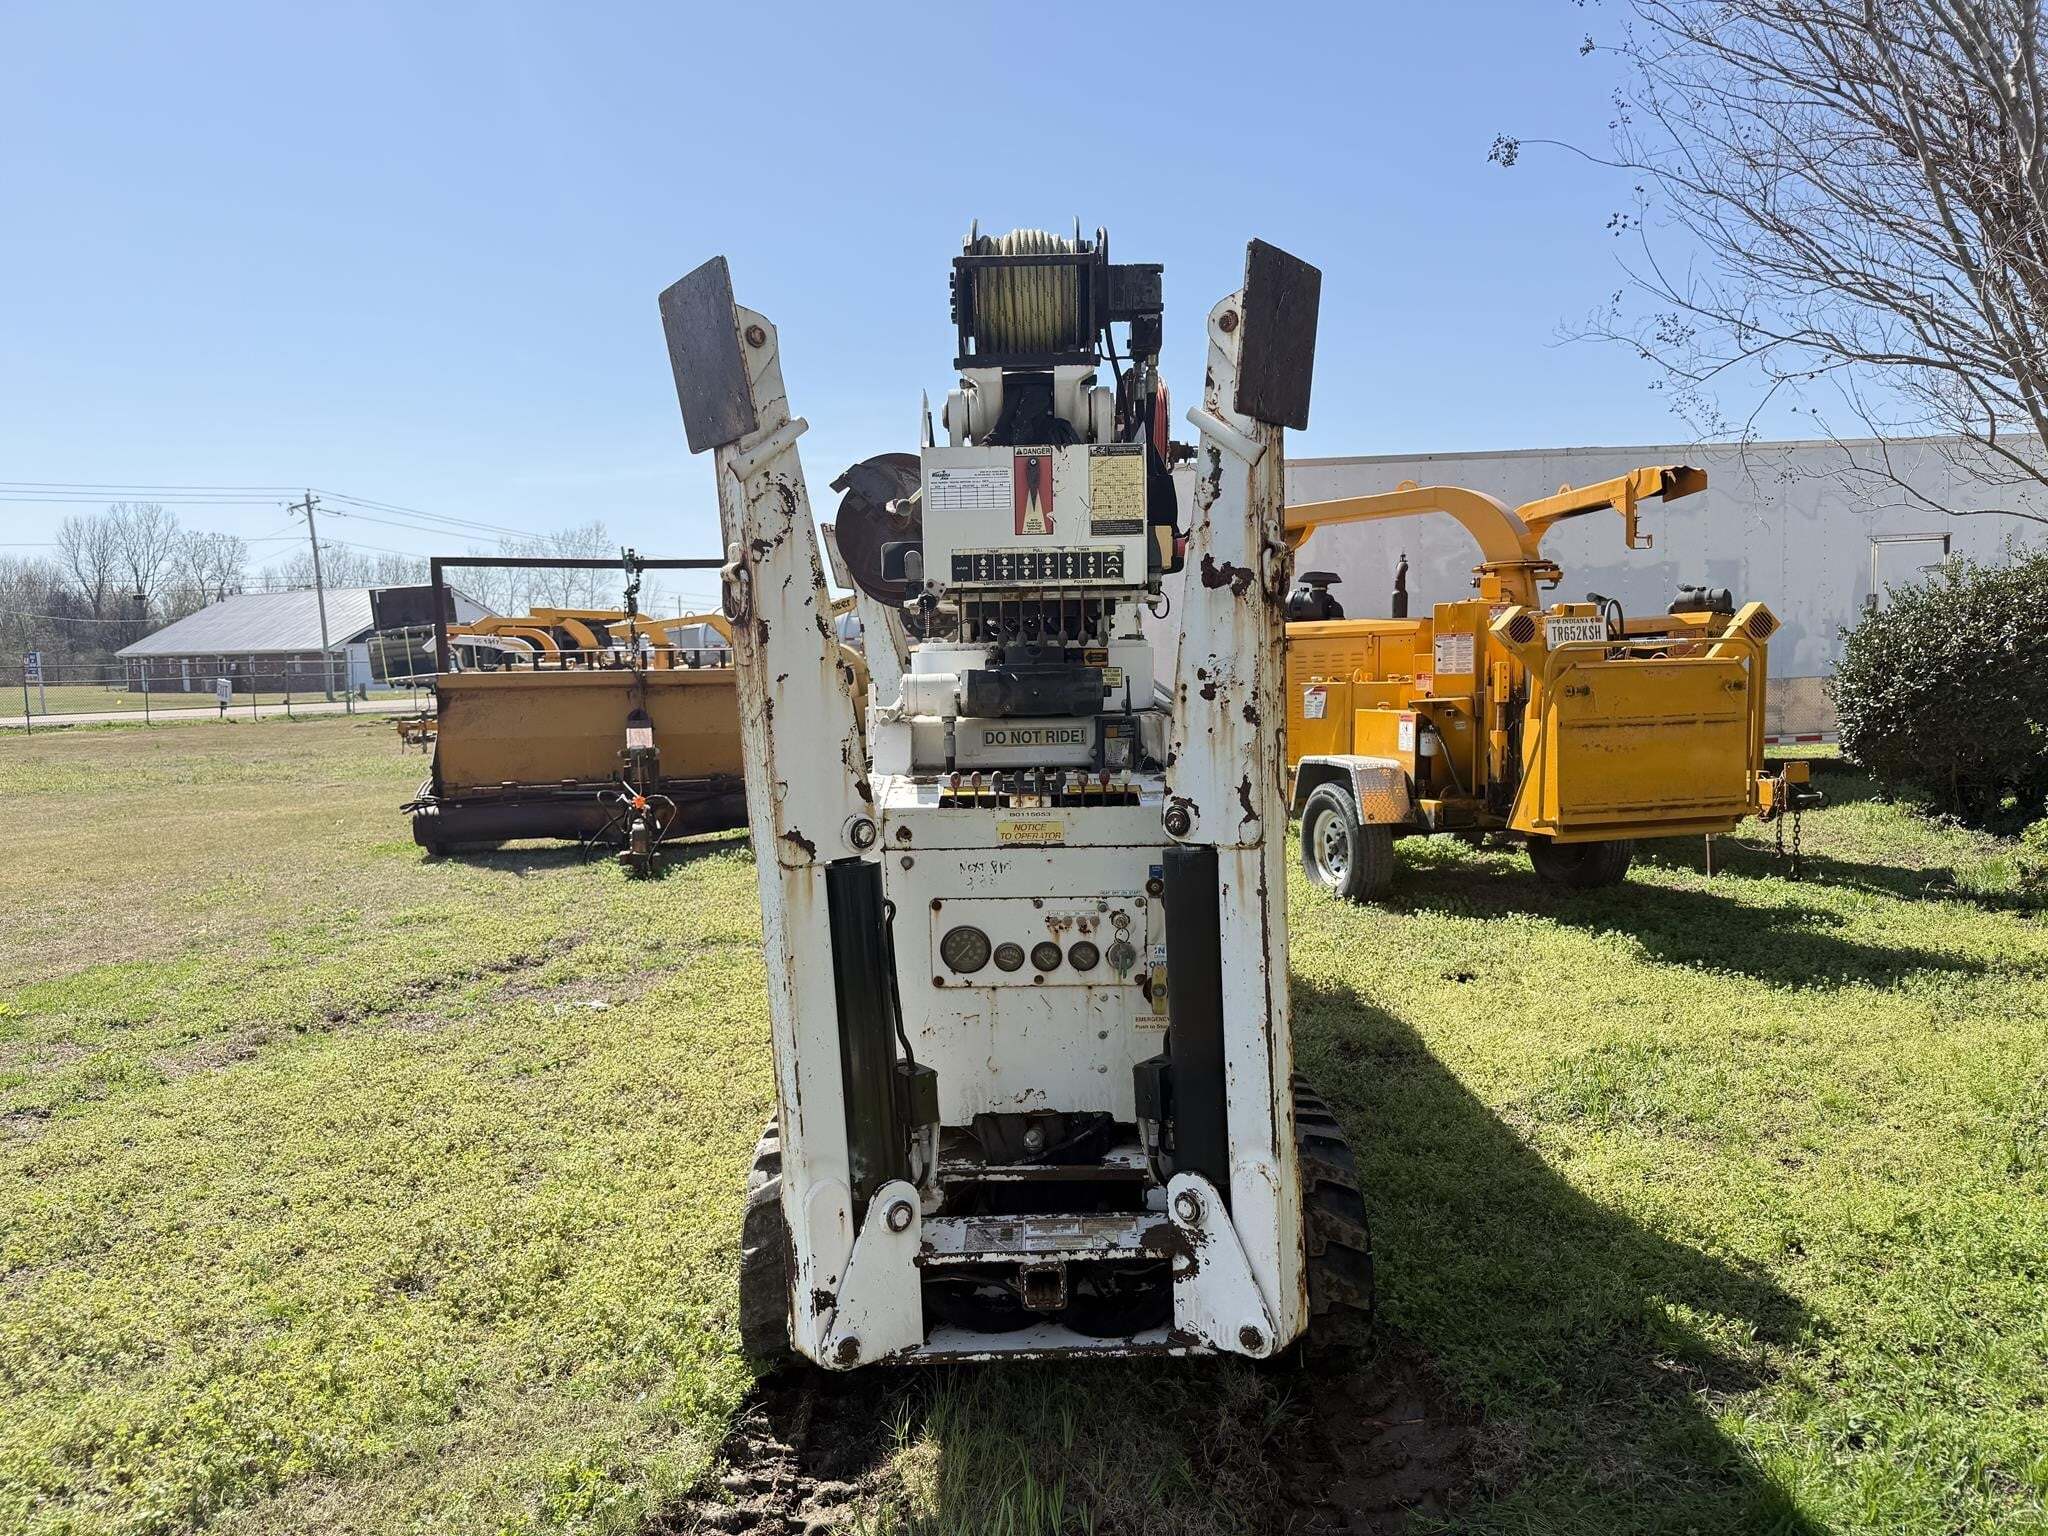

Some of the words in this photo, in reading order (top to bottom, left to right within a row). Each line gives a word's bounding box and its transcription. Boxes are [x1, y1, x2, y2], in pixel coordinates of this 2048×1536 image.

[1023, 447, 1051, 455] DANGER
[1552, 624, 1602, 642] TR652KSH
[985, 731, 1007, 744] DO
[1010, 730, 1041, 744] NOT
[1046, 729, 1085, 742] RIDE!
[1013, 823, 1048, 831] NOTICE
[1000, 832, 1012, 840] TO
[1014, 831, 1062, 840] OPERATOR
